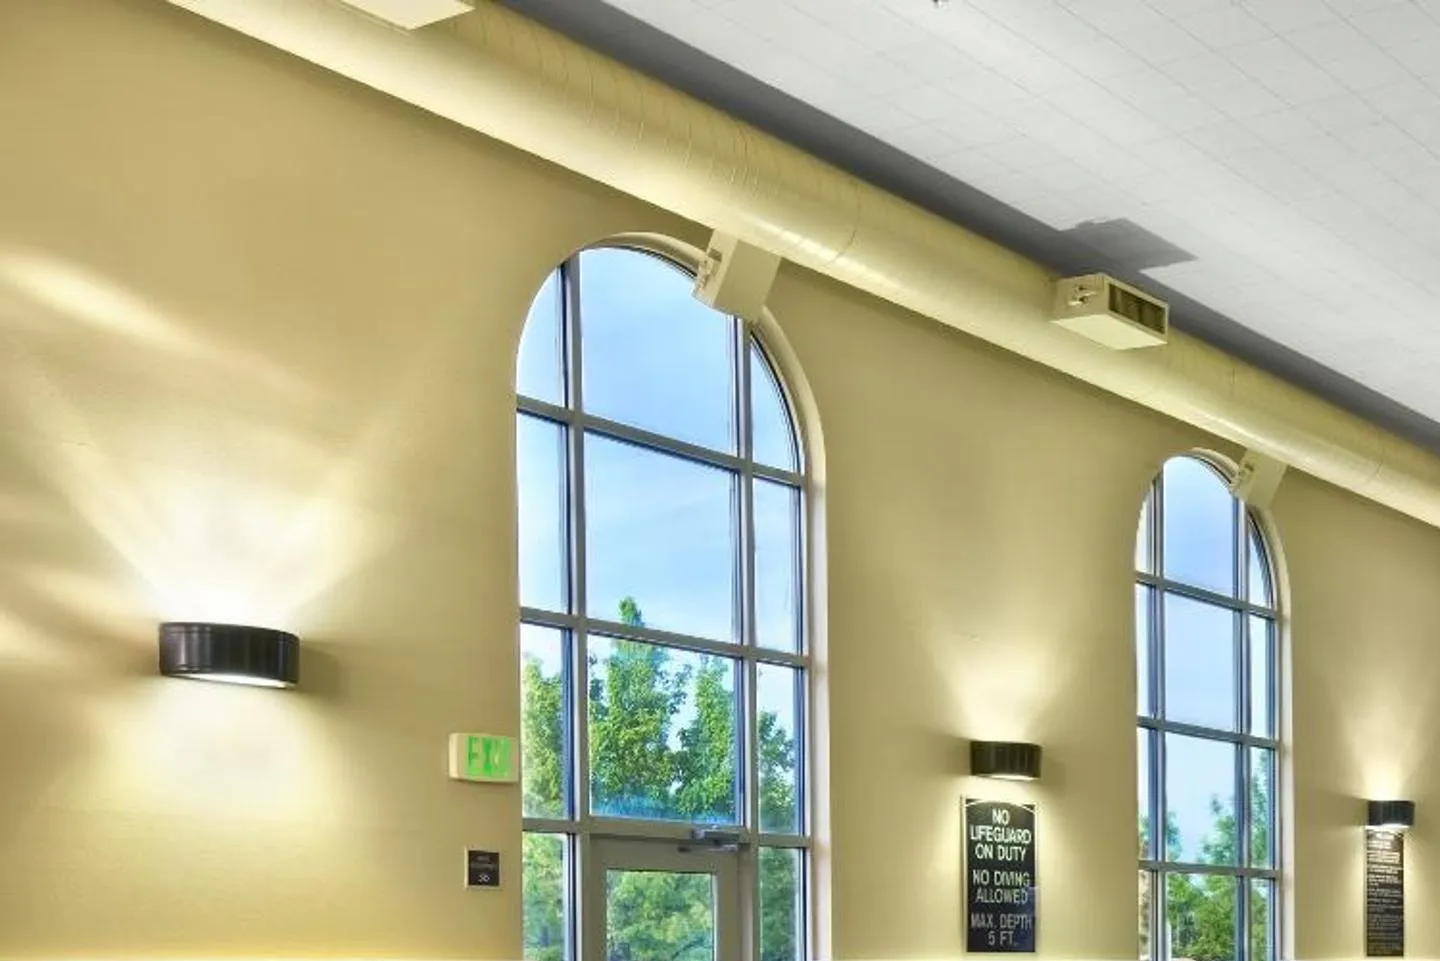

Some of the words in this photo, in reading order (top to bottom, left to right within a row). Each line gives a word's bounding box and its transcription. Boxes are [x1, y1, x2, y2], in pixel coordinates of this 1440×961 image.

[992, 808, 1010, 825] NO
[970, 824, 1031, 845] LIFEGUARD
[975, 843, 993, 859] ON
[998, 844, 1025, 861] DUTY
[972, 869, 989, 885] NO
[994, 870, 1030, 887] DIVING
[975, 887, 1028, 905] ALLOWED
[1000, 913, 1032, 930] DEPTH
[988, 930, 996, 946] 5
